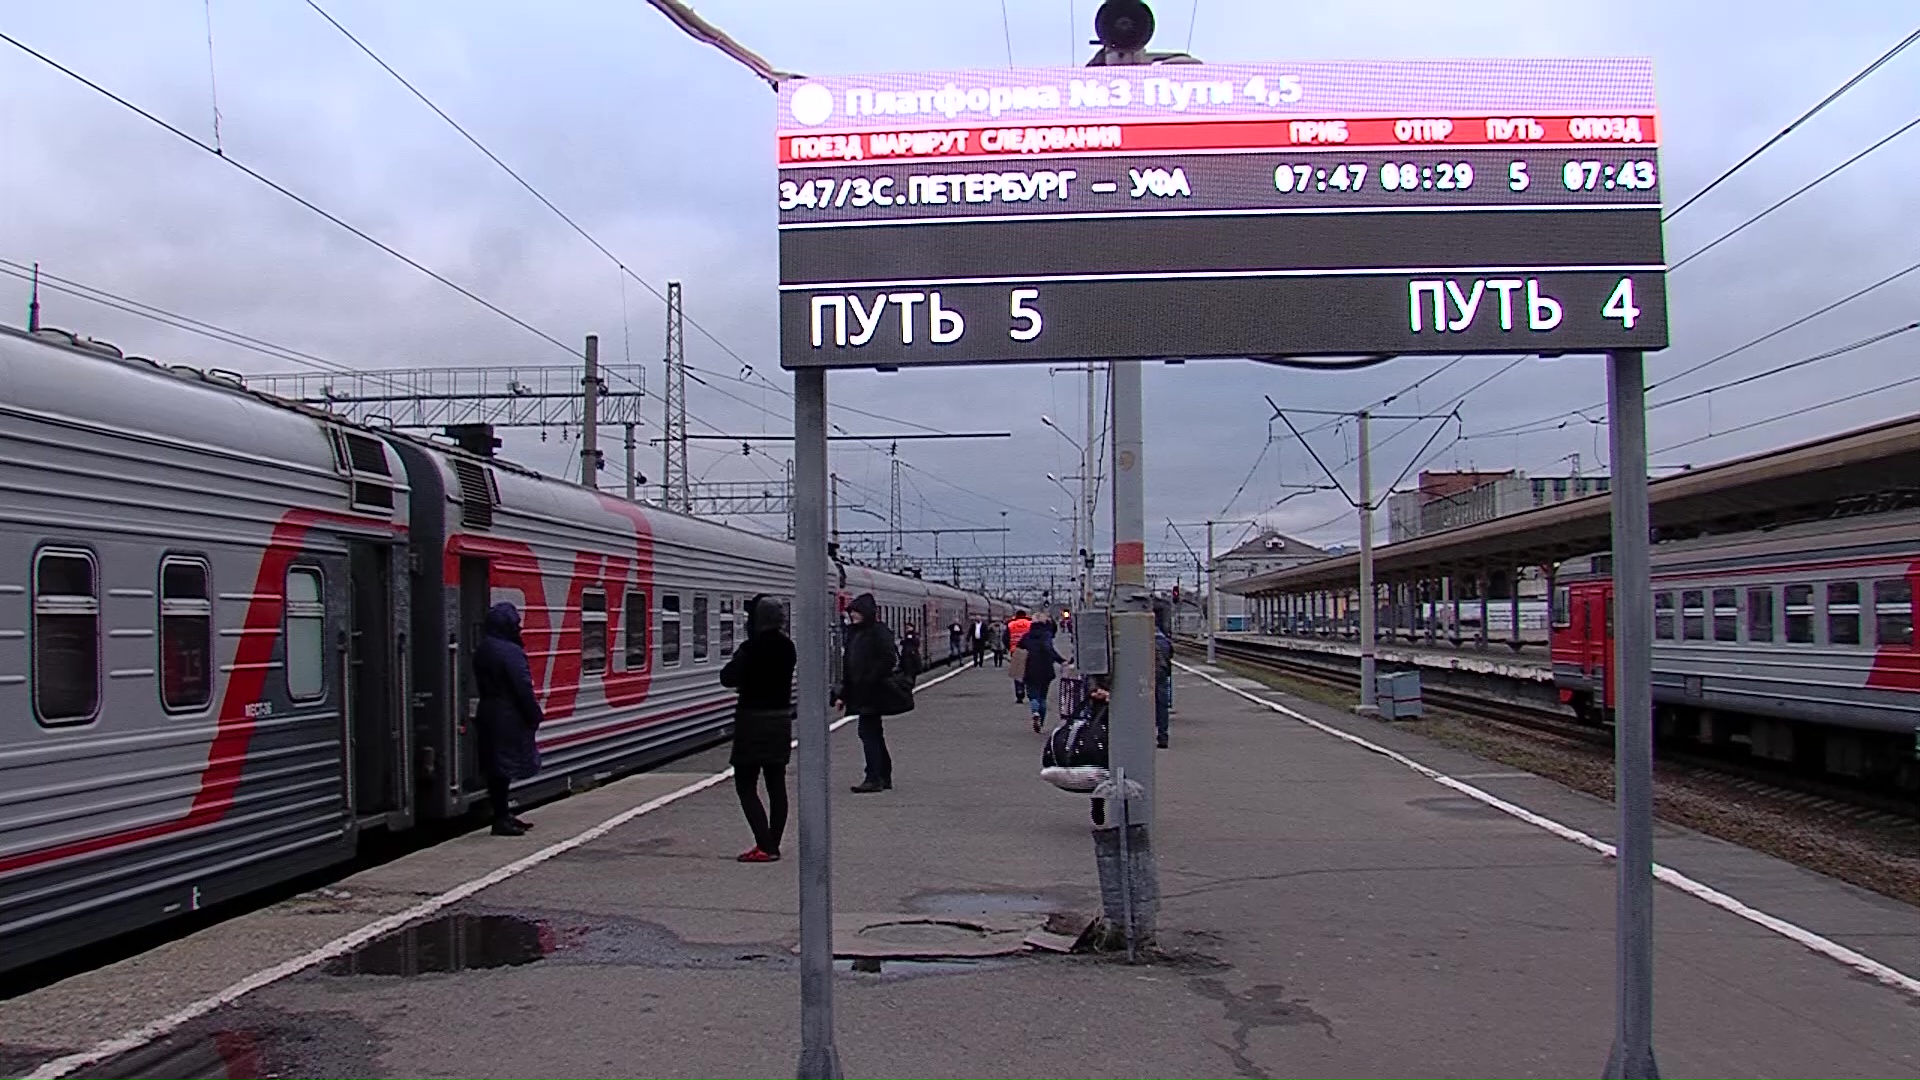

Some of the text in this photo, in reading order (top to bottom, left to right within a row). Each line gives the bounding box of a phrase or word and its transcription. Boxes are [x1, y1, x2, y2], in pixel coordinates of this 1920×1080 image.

[845, 73, 1302, 118] Платформа №3 Пути 4,5
[791, 117, 1643, 161] ПОЕЗД МАРШРУТ СЛЕДОВАНИЯ ПРИБ ОТПР ПУТЬ ОПОЗД
[1129, 168, 1191, 197] УФА
[1275, 164, 1368, 192] 07:47
[1380, 162, 1473, 190] 08:29
[1509, 161, 1529, 191] 5
[1563, 161, 1656, 190] 07:43
[811, 289, 1042, 347] ПУТЬ 5
[1409, 277, 1640, 333] ПУТЬ 4
